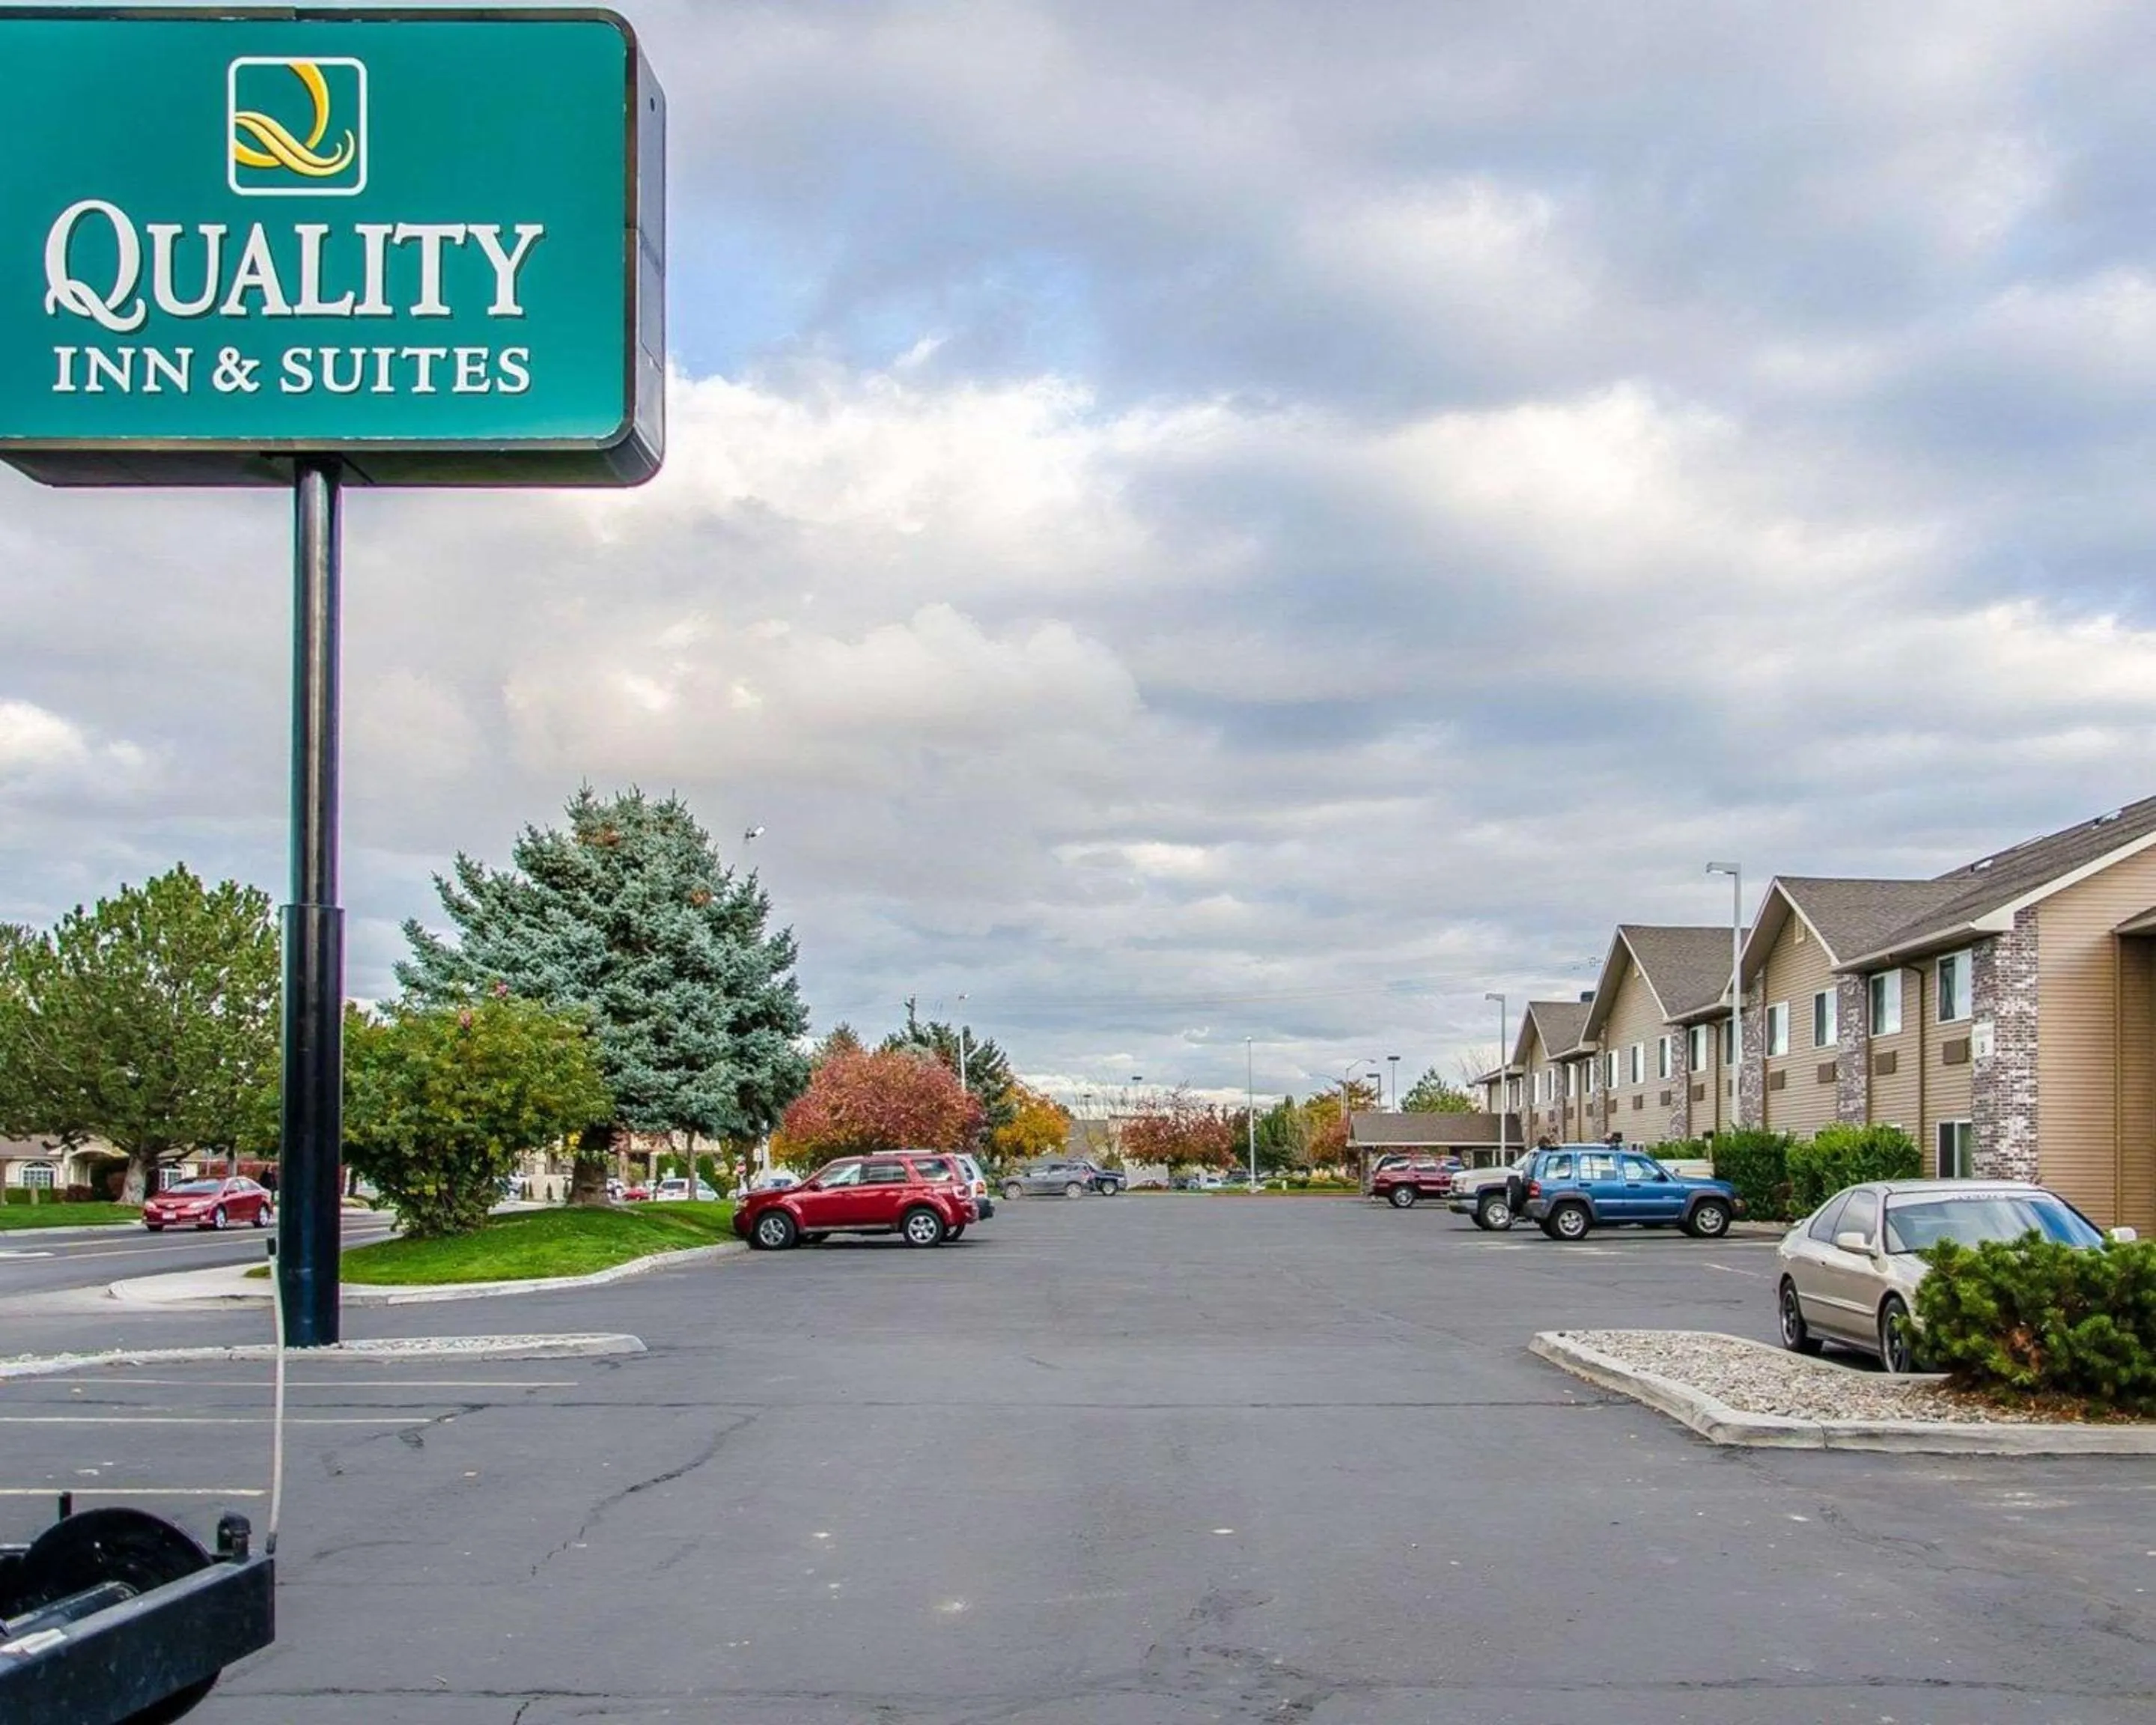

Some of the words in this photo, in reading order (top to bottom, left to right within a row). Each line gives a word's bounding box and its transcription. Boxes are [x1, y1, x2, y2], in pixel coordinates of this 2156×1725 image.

[44, 199, 543, 332] QUALITY
[52, 346, 194, 393] INN
[212, 346, 261, 393] &
[279, 346, 531, 394] SUITES
